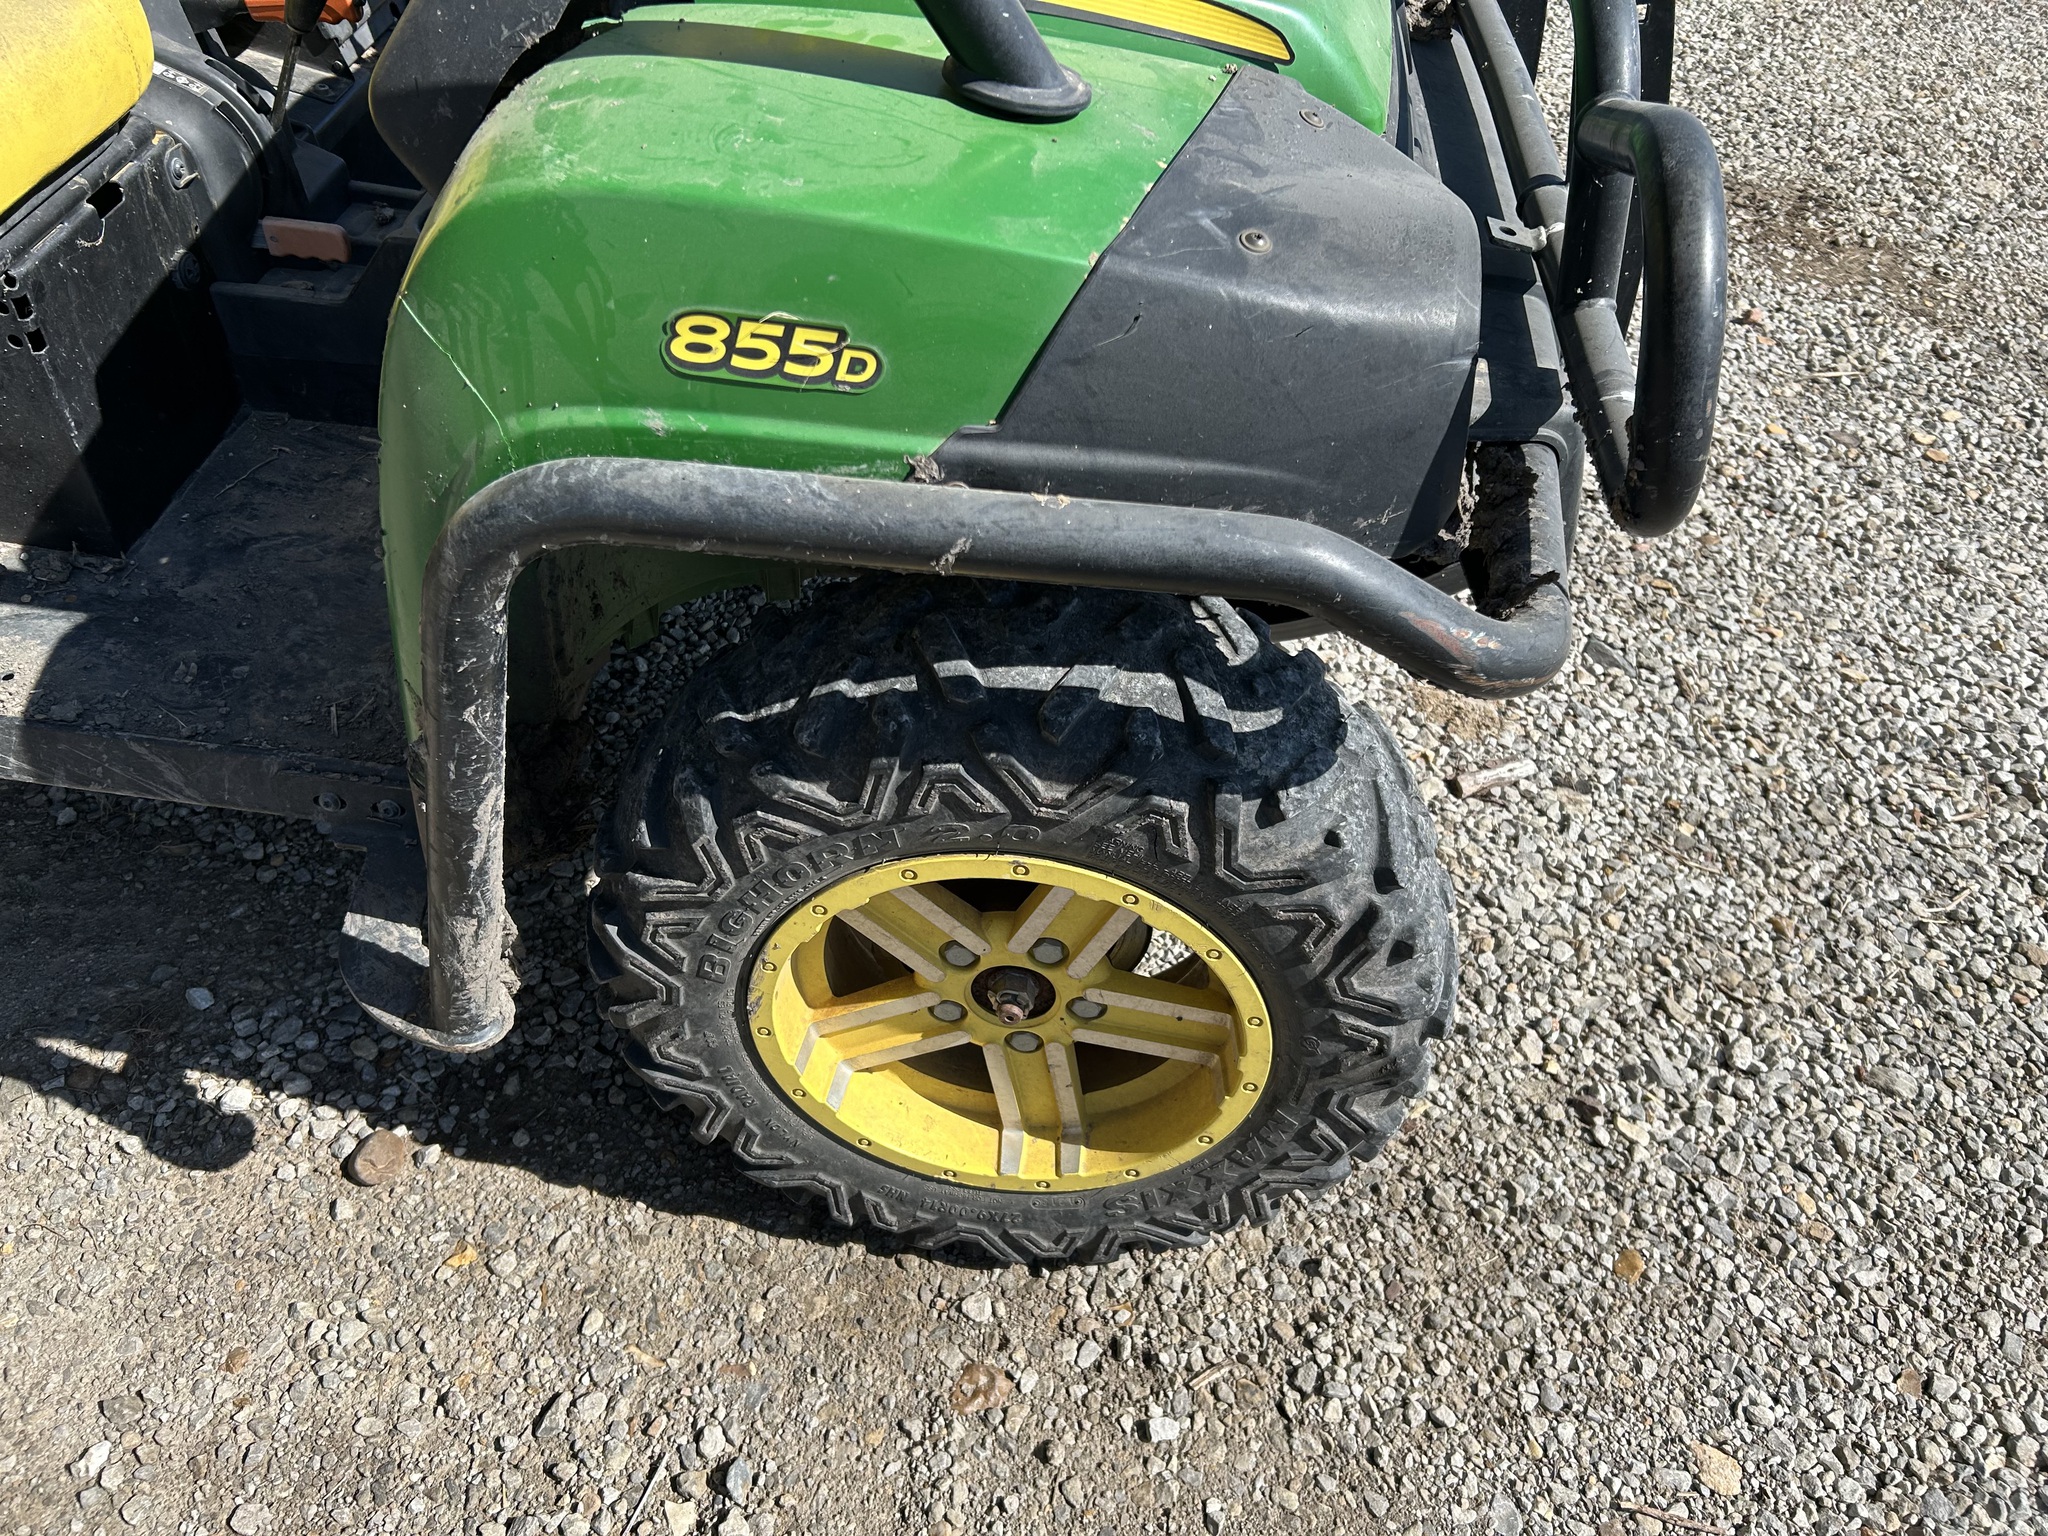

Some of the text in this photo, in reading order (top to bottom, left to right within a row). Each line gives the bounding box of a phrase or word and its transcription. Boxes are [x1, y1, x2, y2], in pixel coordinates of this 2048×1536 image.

[669, 313, 878, 384] 855D
[696, 827, 901, 984] BIGHORN
[929, 821, 1042, 843] 2.0
[717, 1064, 759, 1109] RADIAL
[1102, 1108, 1299, 1217] MAXXIS
